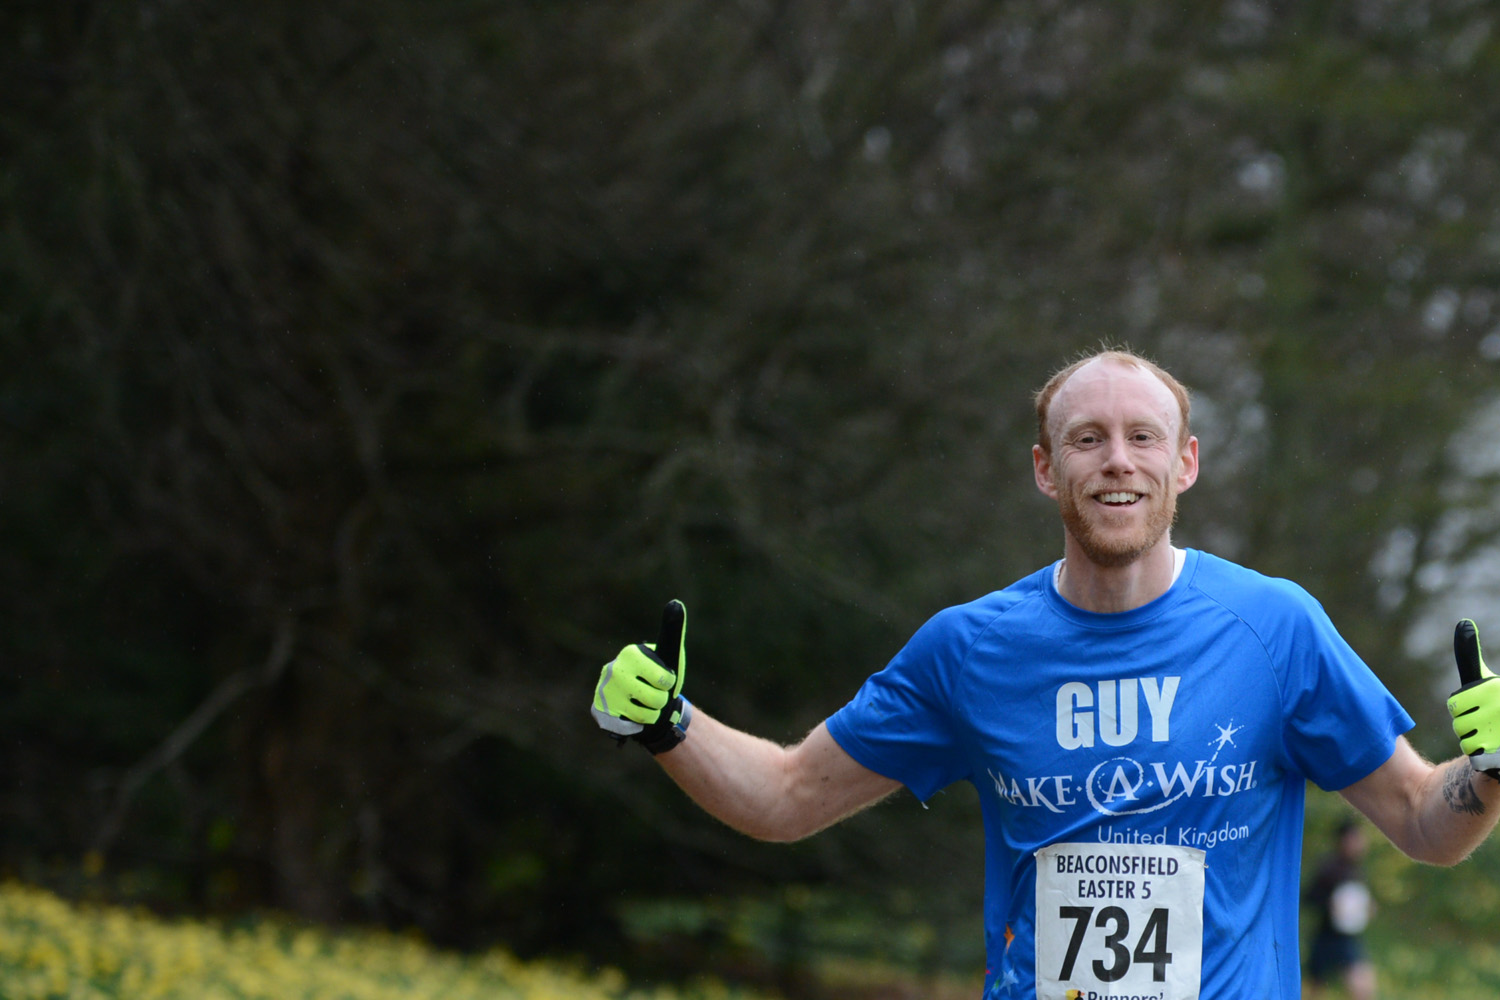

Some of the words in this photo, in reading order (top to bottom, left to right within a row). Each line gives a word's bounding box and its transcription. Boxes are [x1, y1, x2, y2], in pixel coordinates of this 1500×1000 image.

[1056, 676, 1181, 750] GUY
[1098, 825, 1166, 845] United
[1179, 821, 1249, 849] Kingdom
[1057, 855, 1179, 876] BEACONSFIELD
[1078, 880, 1135, 898] EASTER
[1141, 881, 1152, 899] 5
[1058, 905, 1172, 982] 734
